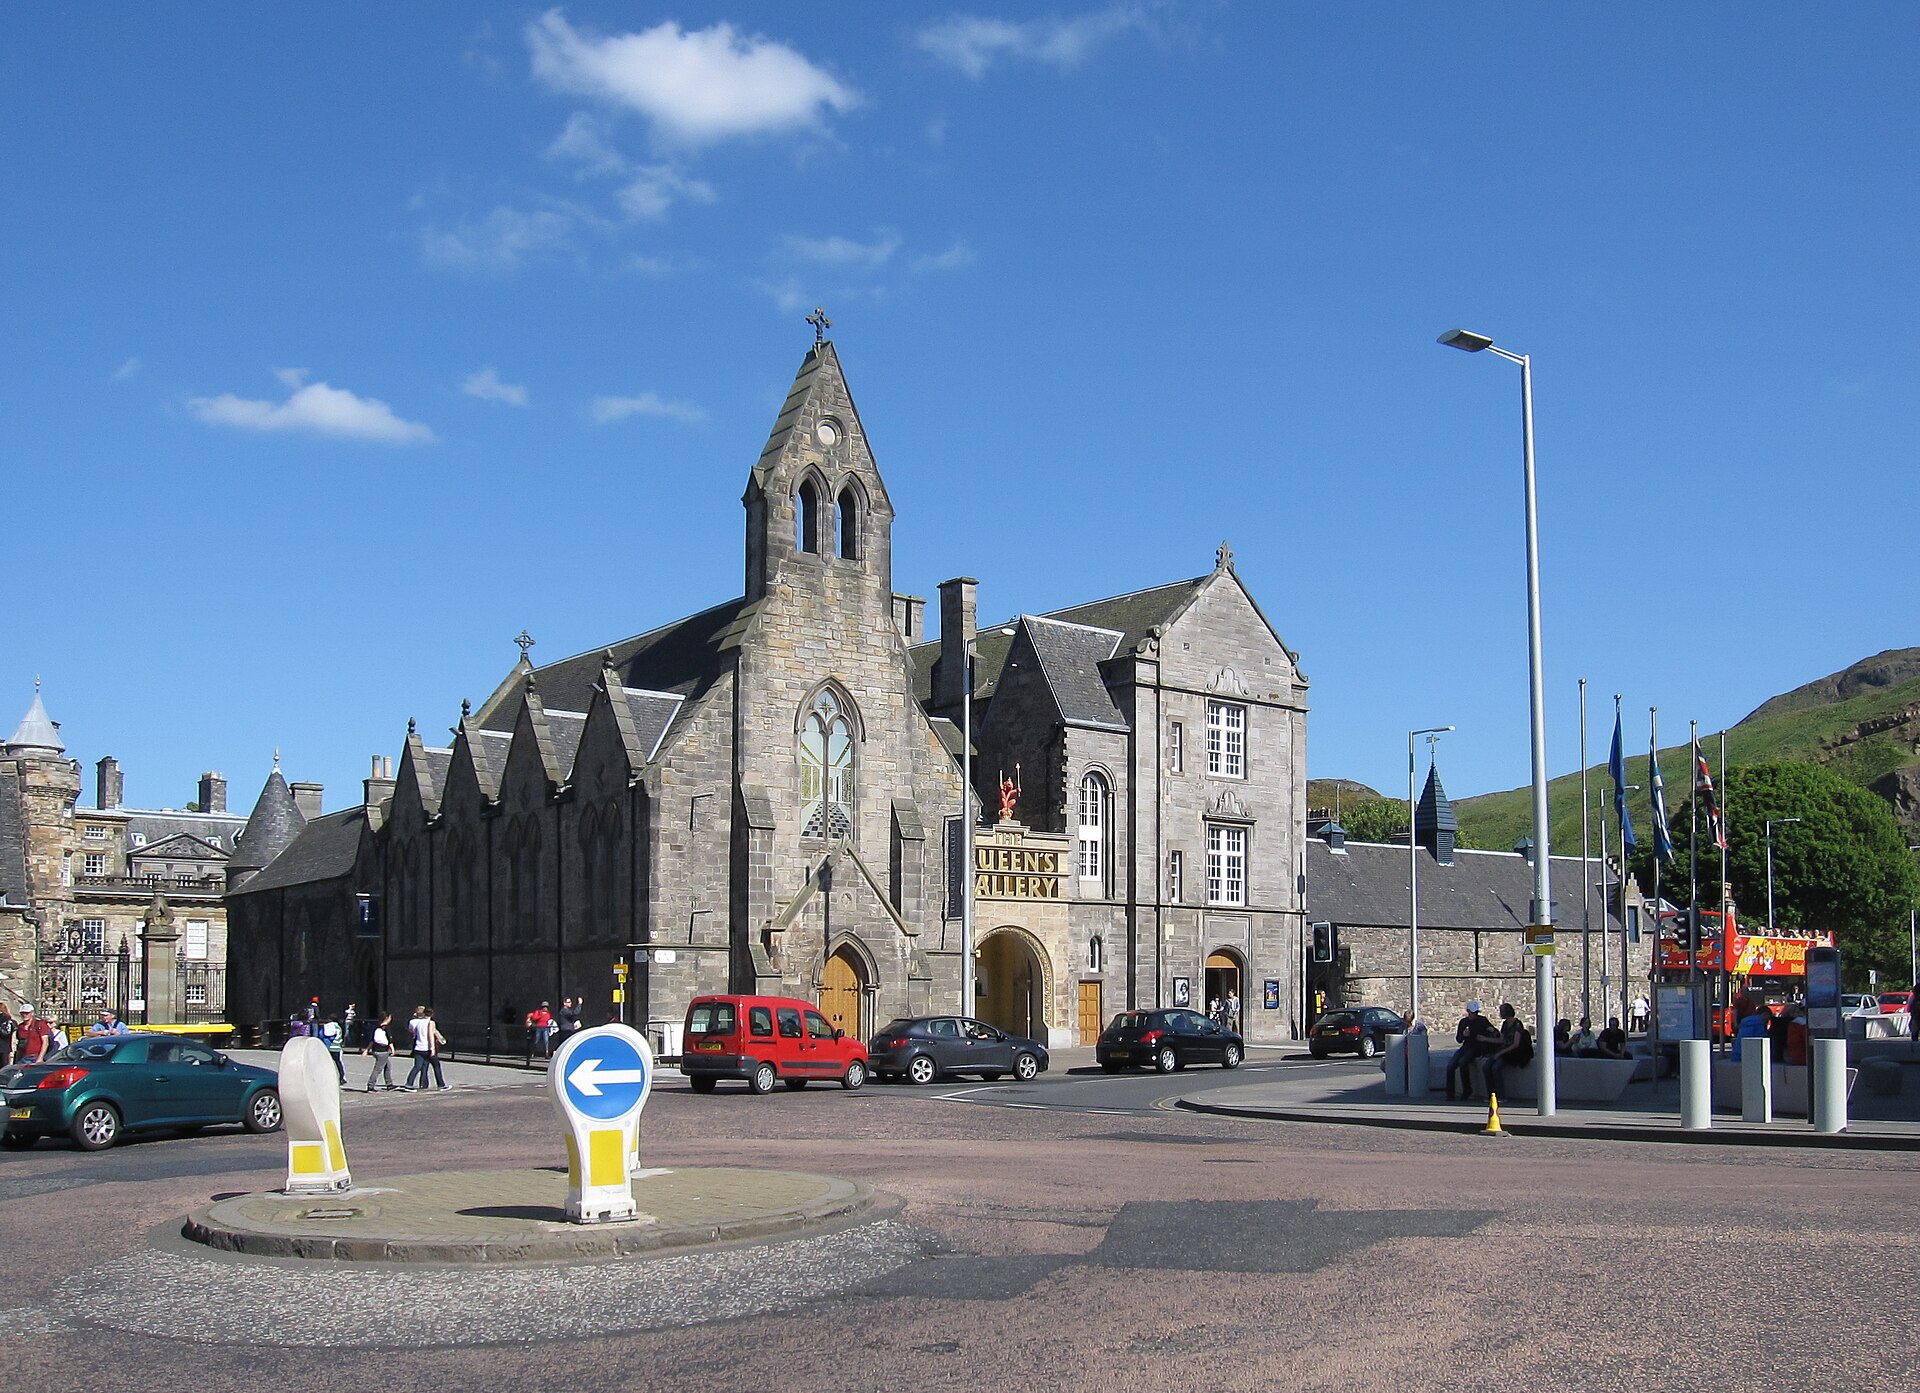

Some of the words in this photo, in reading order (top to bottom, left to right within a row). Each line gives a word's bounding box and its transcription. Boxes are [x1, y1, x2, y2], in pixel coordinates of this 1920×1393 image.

[995, 832, 1023, 846] THE
[975, 848, 1054, 873] UEEN'S
[974, 873, 1057, 898] ALLERY
